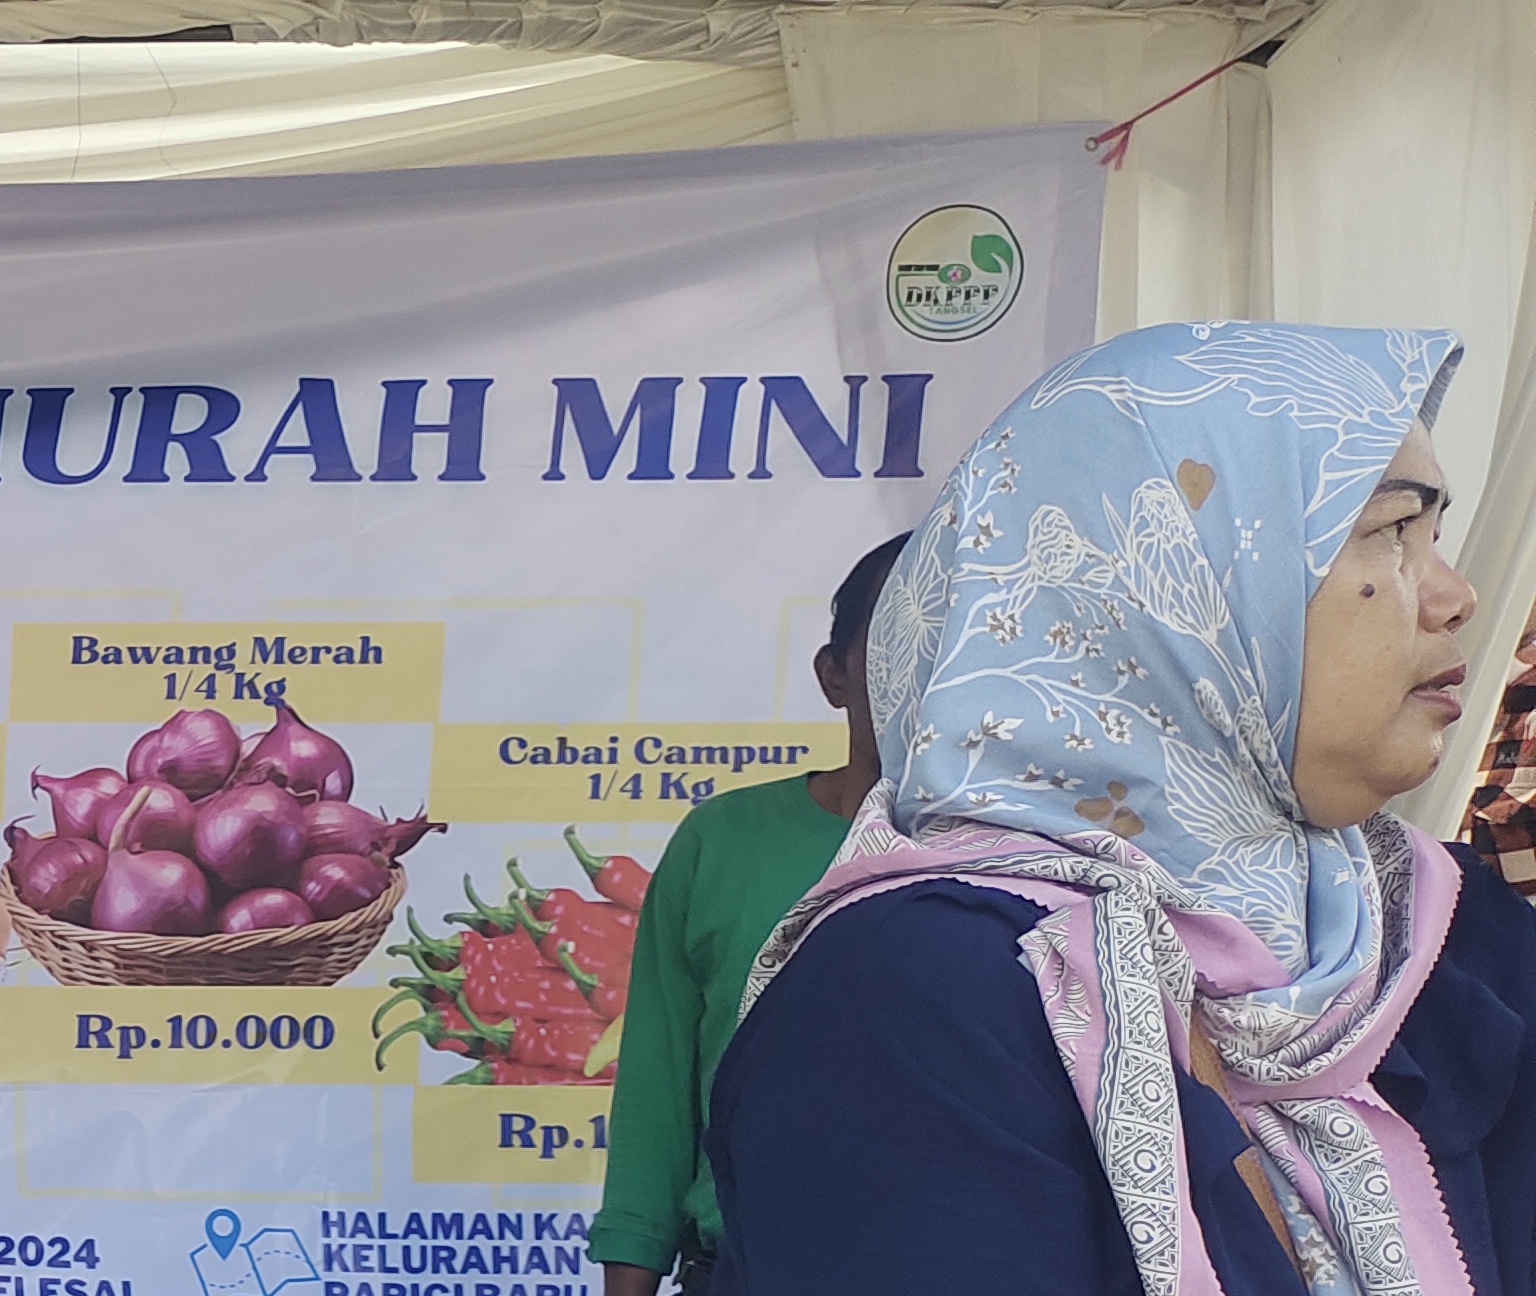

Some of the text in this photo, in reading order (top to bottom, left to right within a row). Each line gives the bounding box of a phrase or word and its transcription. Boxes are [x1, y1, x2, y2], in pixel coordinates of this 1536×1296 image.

[541, 372, 934, 482] MINI
[70, 633, 384, 674] Bawang Merah
[162, 669, 288, 707] 1/4 Kg
[498, 734, 810, 775] Cabai Campur
[587, 770, 715, 804] 1/4 Kg
[74, 1012, 336, 1060] Rp.10.000
[321, 1210, 524, 1241] HALAMAN
[323, 1243, 581, 1276] KELURAHAN
